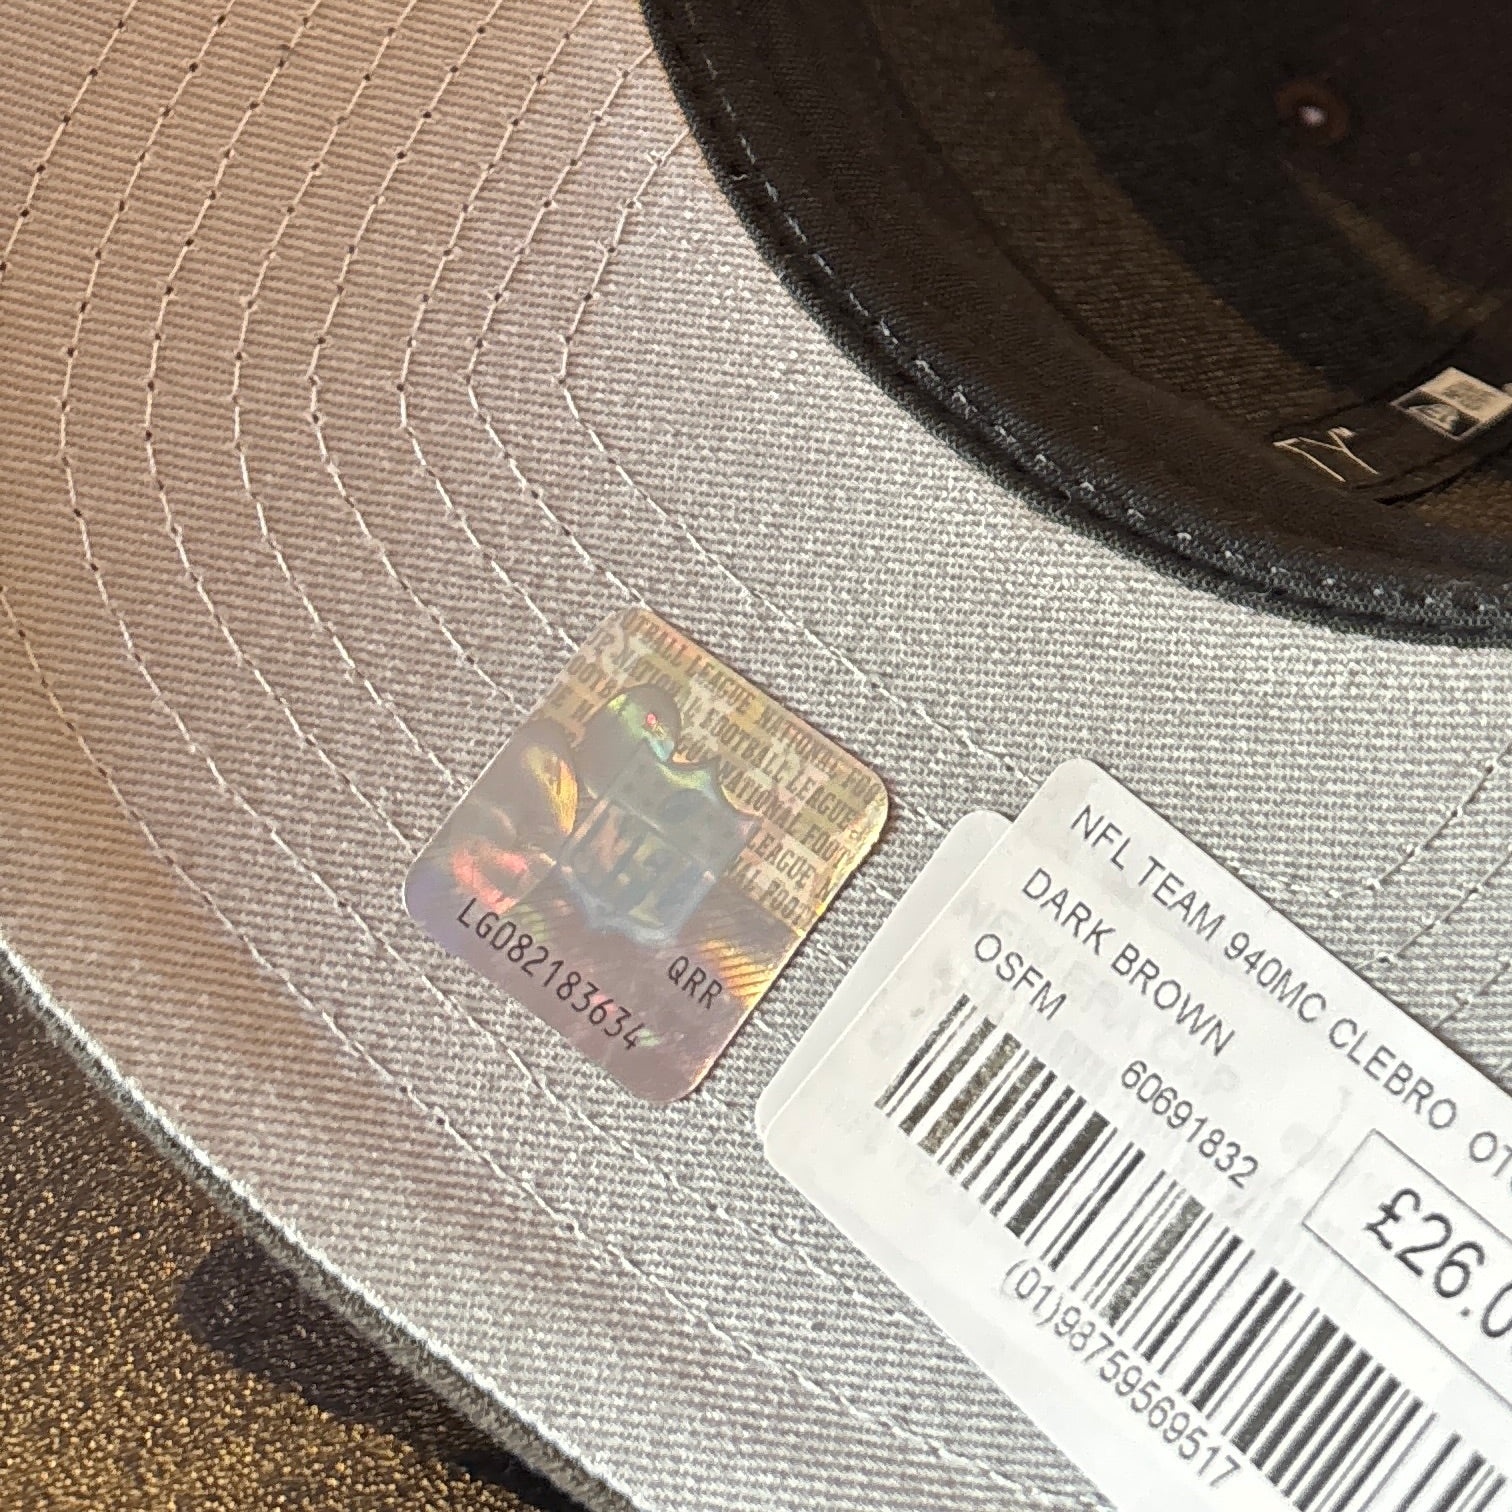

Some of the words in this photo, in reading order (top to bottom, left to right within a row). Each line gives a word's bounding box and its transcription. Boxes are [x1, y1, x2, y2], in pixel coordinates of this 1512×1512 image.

[684, 652, 758, 717] LEAGUE
[754, 702, 847, 781] NATIONAL
[698, 704, 794, 785] FOOTBALL
[784, 767, 859, 833] LEAGUE
[713, 758, 807, 837] NATIONAL
[744, 823, 819, 889] LEAGUE
[456, 897, 646, 1051] LG082183634
[667, 955, 723, 1010] QRR
[1021, 866, 1117, 957] DARK
[1110, 943, 1236, 1058] BROWN
[1069, 803, 1132, 871] NFL
[1142, 856, 1228, 943] TEAM
[1224, 931, 1328, 1027] 940MC
[1328, 1017, 1458, 1133] CLEBRO
[973, 932, 1068, 1023] OSFM
[1120, 1059, 1260, 1190] 60691832
[1001, 1257, 1243, 1488] (01)98759569517
